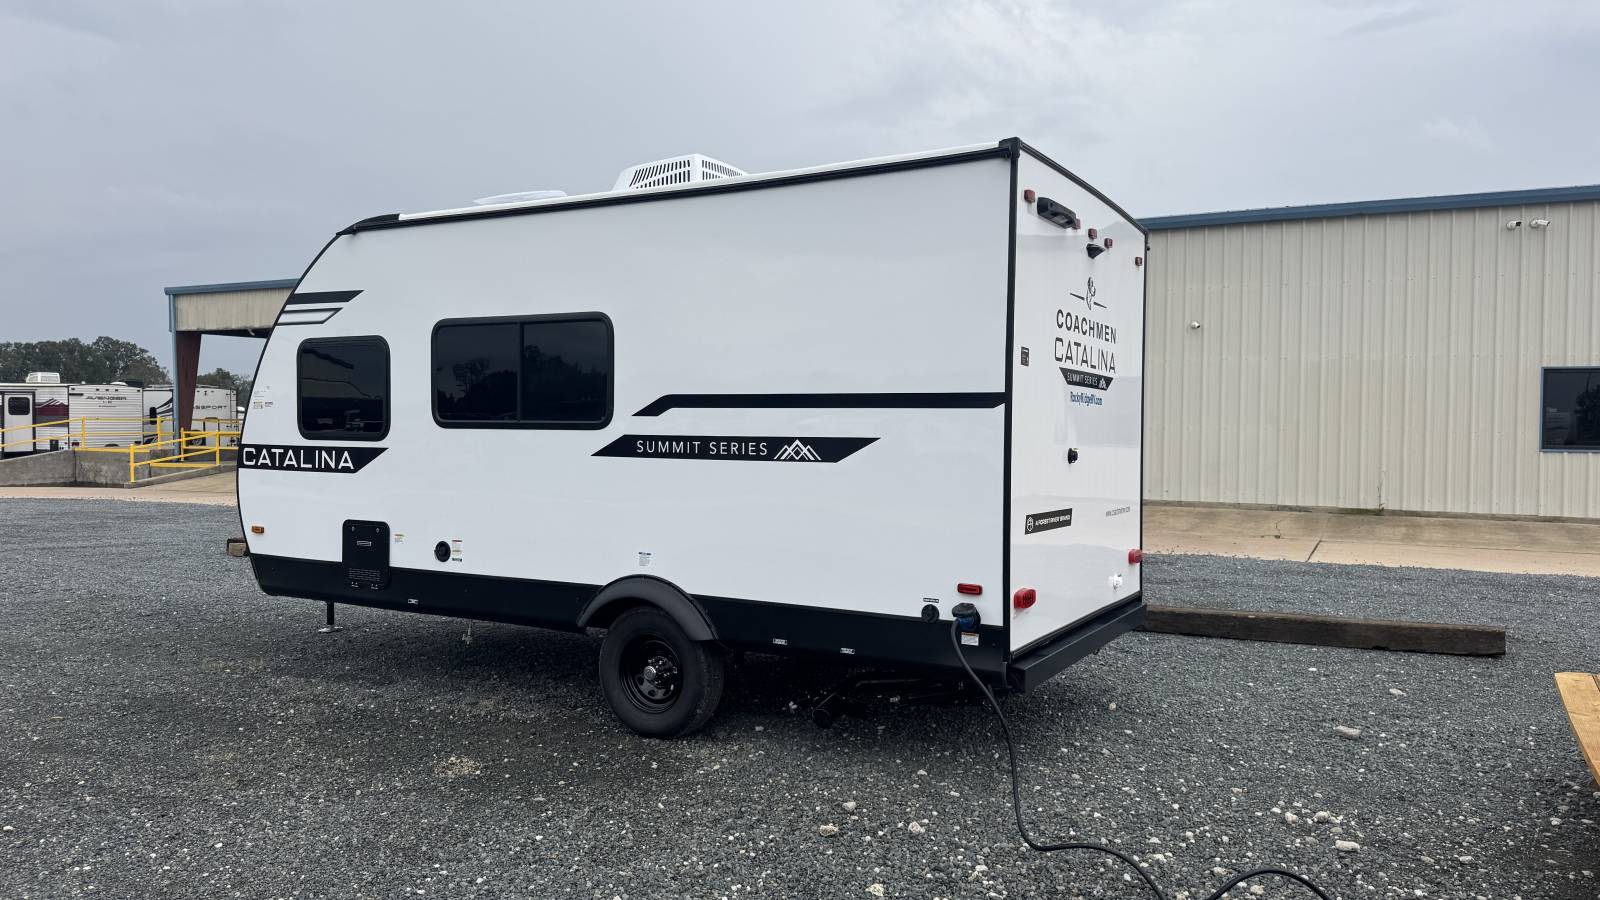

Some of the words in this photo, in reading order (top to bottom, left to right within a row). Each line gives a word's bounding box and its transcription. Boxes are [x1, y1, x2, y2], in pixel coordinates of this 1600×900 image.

[1056, 309, 1117, 344] COACHMEN
[1054, 337, 1116, 374] CATALINA
[1067, 371, 1083, 383] SUMMIT
[636, 440, 701, 454] SUMMIT
[709, 442, 768, 455] SERIES
[243, 448, 354, 470] CATALINA
